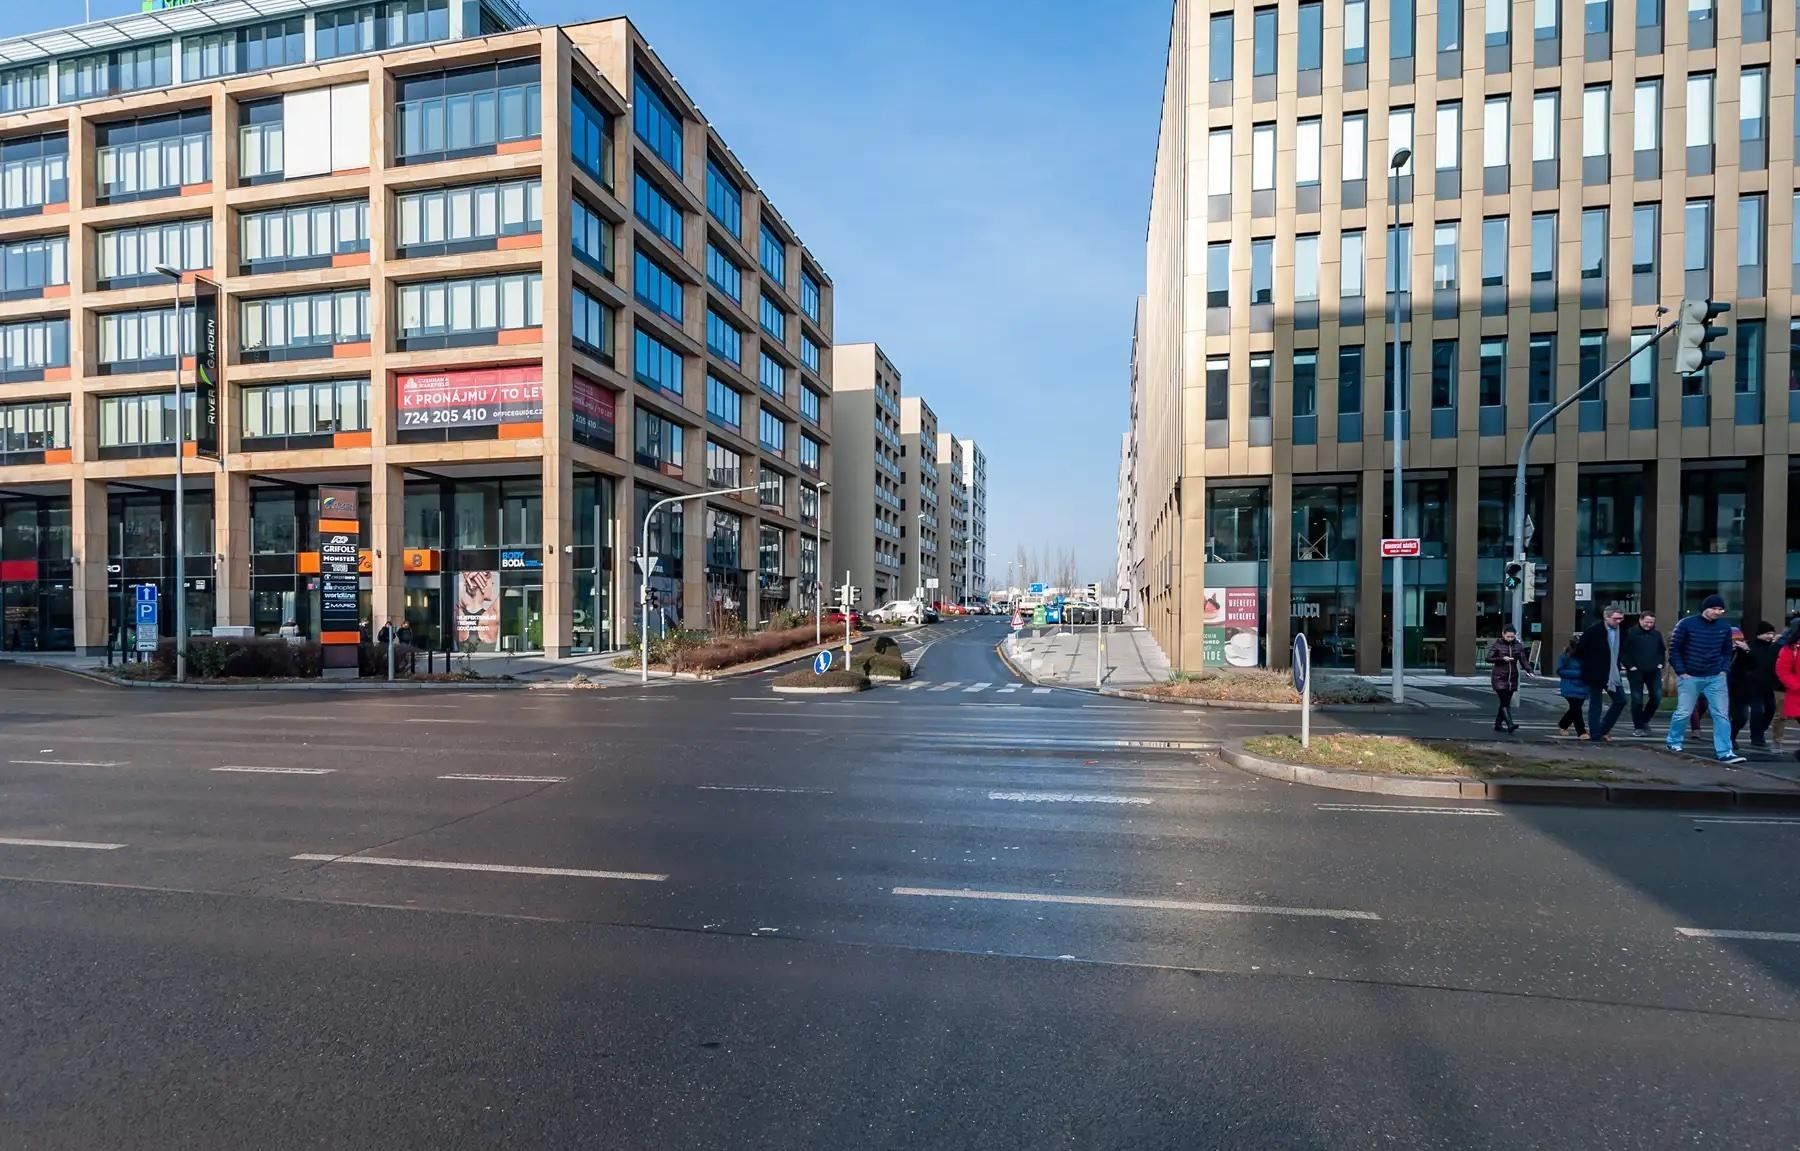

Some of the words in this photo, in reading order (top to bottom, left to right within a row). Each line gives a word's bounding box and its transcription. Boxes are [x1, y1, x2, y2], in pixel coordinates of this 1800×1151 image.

[207, 319, 215, 369] GARDEN
[403, 394, 412, 406] K
[416, 387, 487, 405] PRONÁJMU
[500, 388, 519, 400] TO
[207, 390, 216, 425] RIVER
[404, 411, 429, 425] 724
[432, 409, 459, 423] 205
[462, 407, 487, 421] 410
[323, 545, 356, 553] GRIFOLS
[502, 551, 525, 559] BODY
[502, 559, 526, 568] BODY
[140, 604, 153, 618] P
